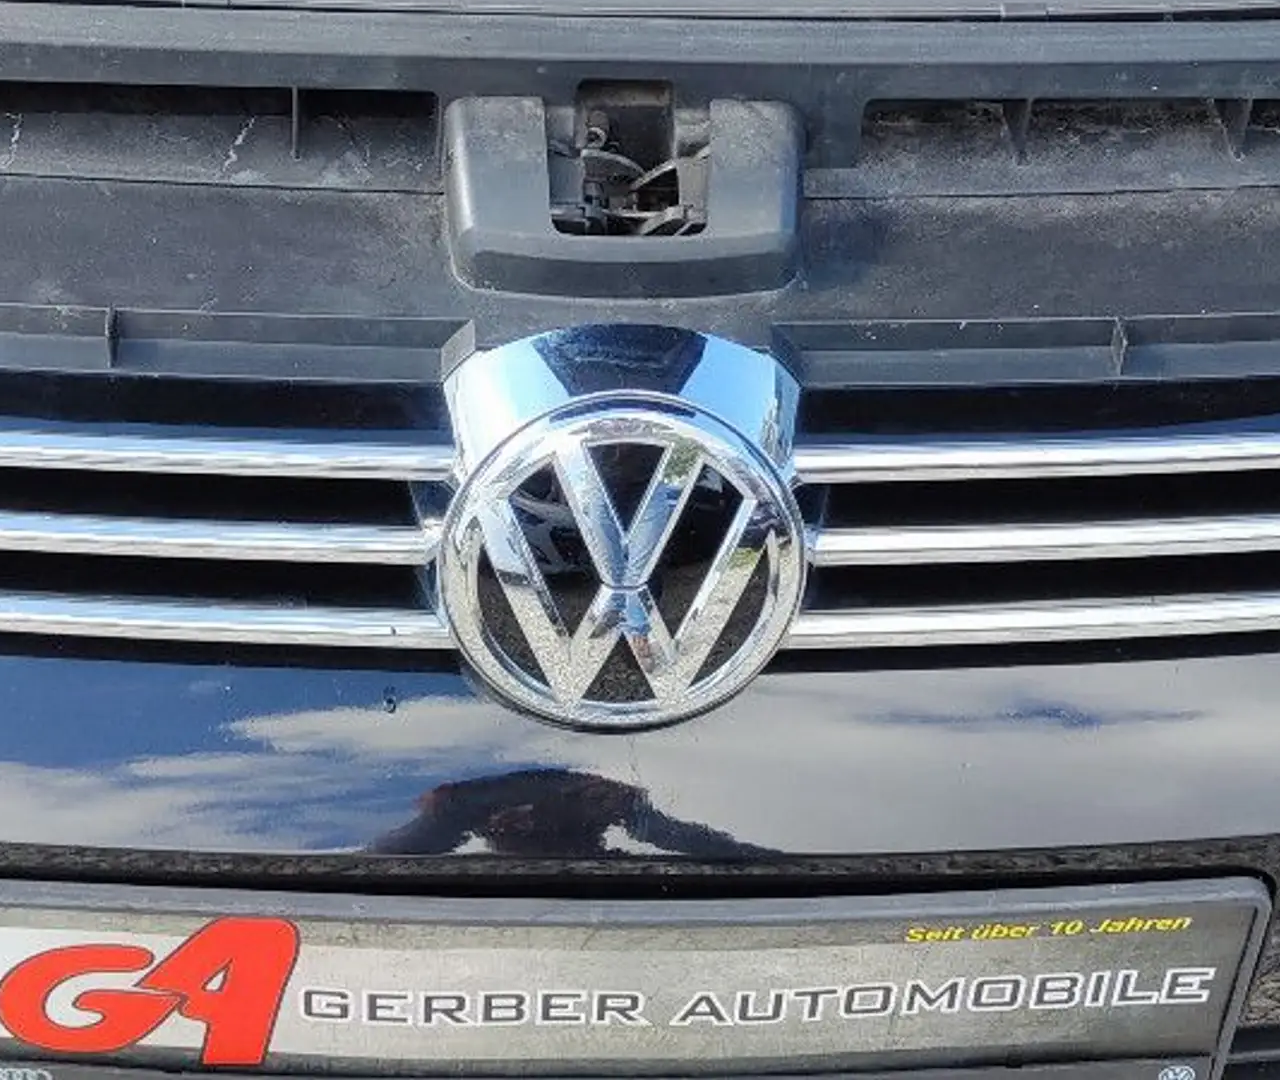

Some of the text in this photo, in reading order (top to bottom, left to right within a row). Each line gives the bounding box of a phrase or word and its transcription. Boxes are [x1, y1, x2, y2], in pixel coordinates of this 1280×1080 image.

[455, 408, 790, 722] VW
[905, 915, 1194, 942] Seit über 10 Jahren
[300, 967, 1217, 1026] GERBER AUTOMOBILE
